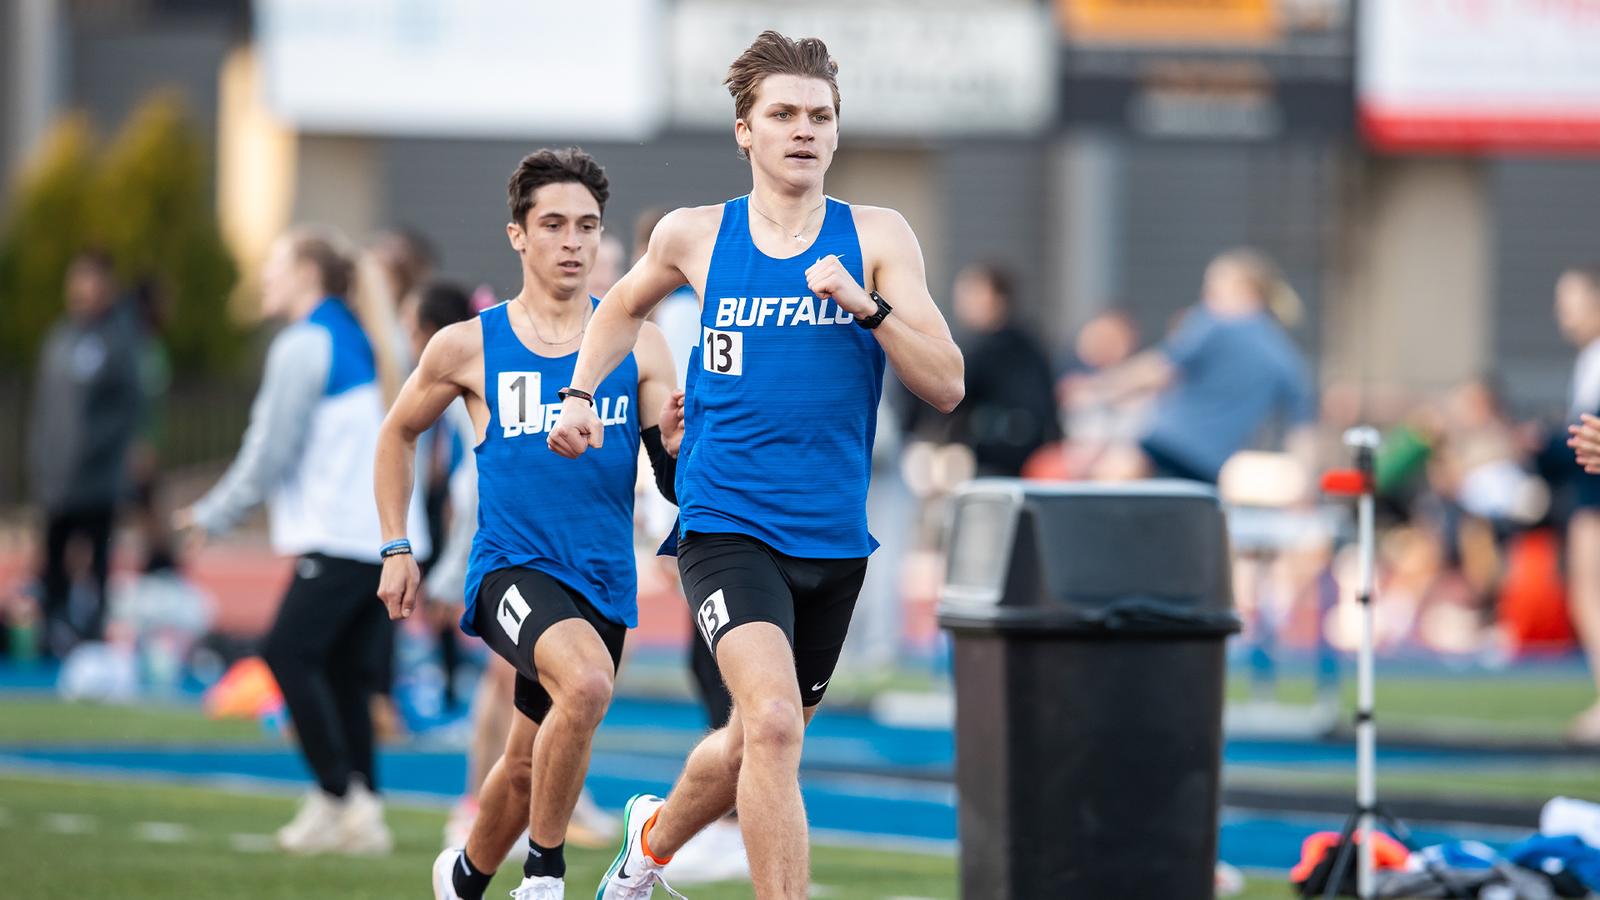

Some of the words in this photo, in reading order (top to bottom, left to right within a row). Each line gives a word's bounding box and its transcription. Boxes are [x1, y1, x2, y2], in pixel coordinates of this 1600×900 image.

[707, 332, 732, 373] 13
[510, 376, 526, 423] 1
[503, 597, 522, 625] 1
[700, 599, 720, 642] 13
